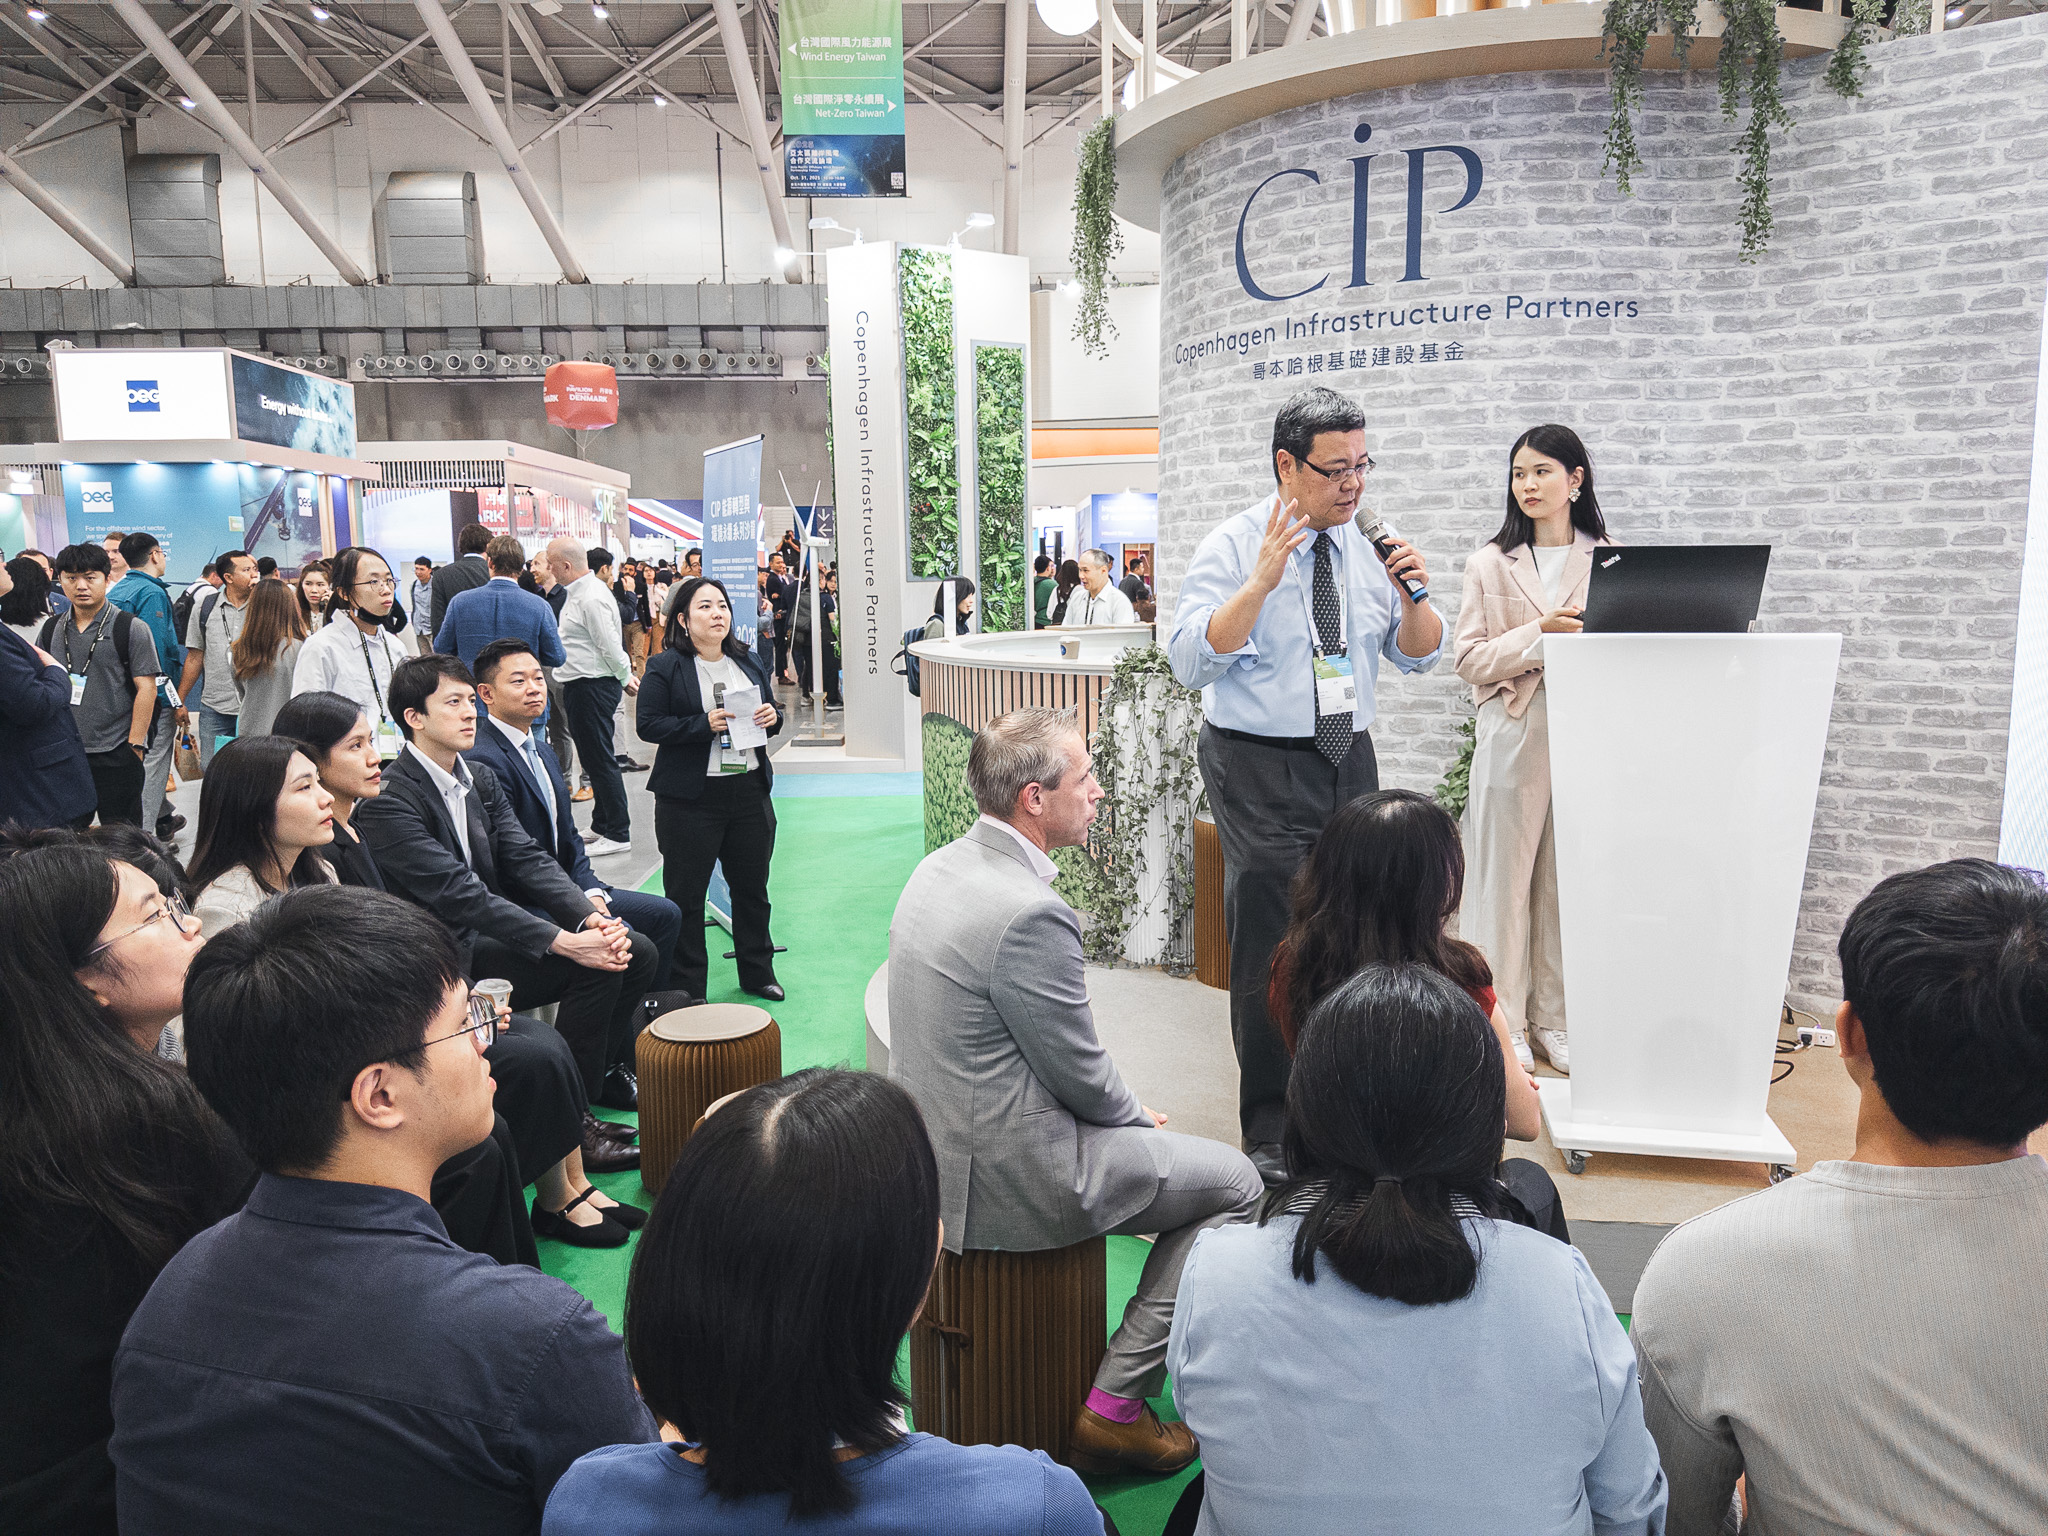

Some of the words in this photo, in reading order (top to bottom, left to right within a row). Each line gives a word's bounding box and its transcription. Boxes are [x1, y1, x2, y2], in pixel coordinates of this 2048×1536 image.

[800, 37, 892, 48] 台灣國際風力能源展
[800, 52, 823, 61] Wind
[825, 52, 855, 63] Energy
[856, 52, 886, 61] Taiwan
[793, 94, 885, 105] 台灣國際淨零永續展
[815, 109, 853, 118] Net-Zero
[855, 109, 885, 118] Taiwan
[1174, 325, 1276, 366] Copenhagen
[1285, 302, 1492, 341] Infrastructure
[1506, 295, 1639, 319] Partners
[1252, 340, 1465, 381] 哥本哈根基礎建設基金
[853, 310, 871, 441] Copenhagen
[260, 394, 287, 416] Energy
[569, 393, 608, 403] DENMARK
[711, 500, 721, 518] CIP
[860, 449, 876, 587] Infrastructure
[865, 594, 878, 675] Partners
